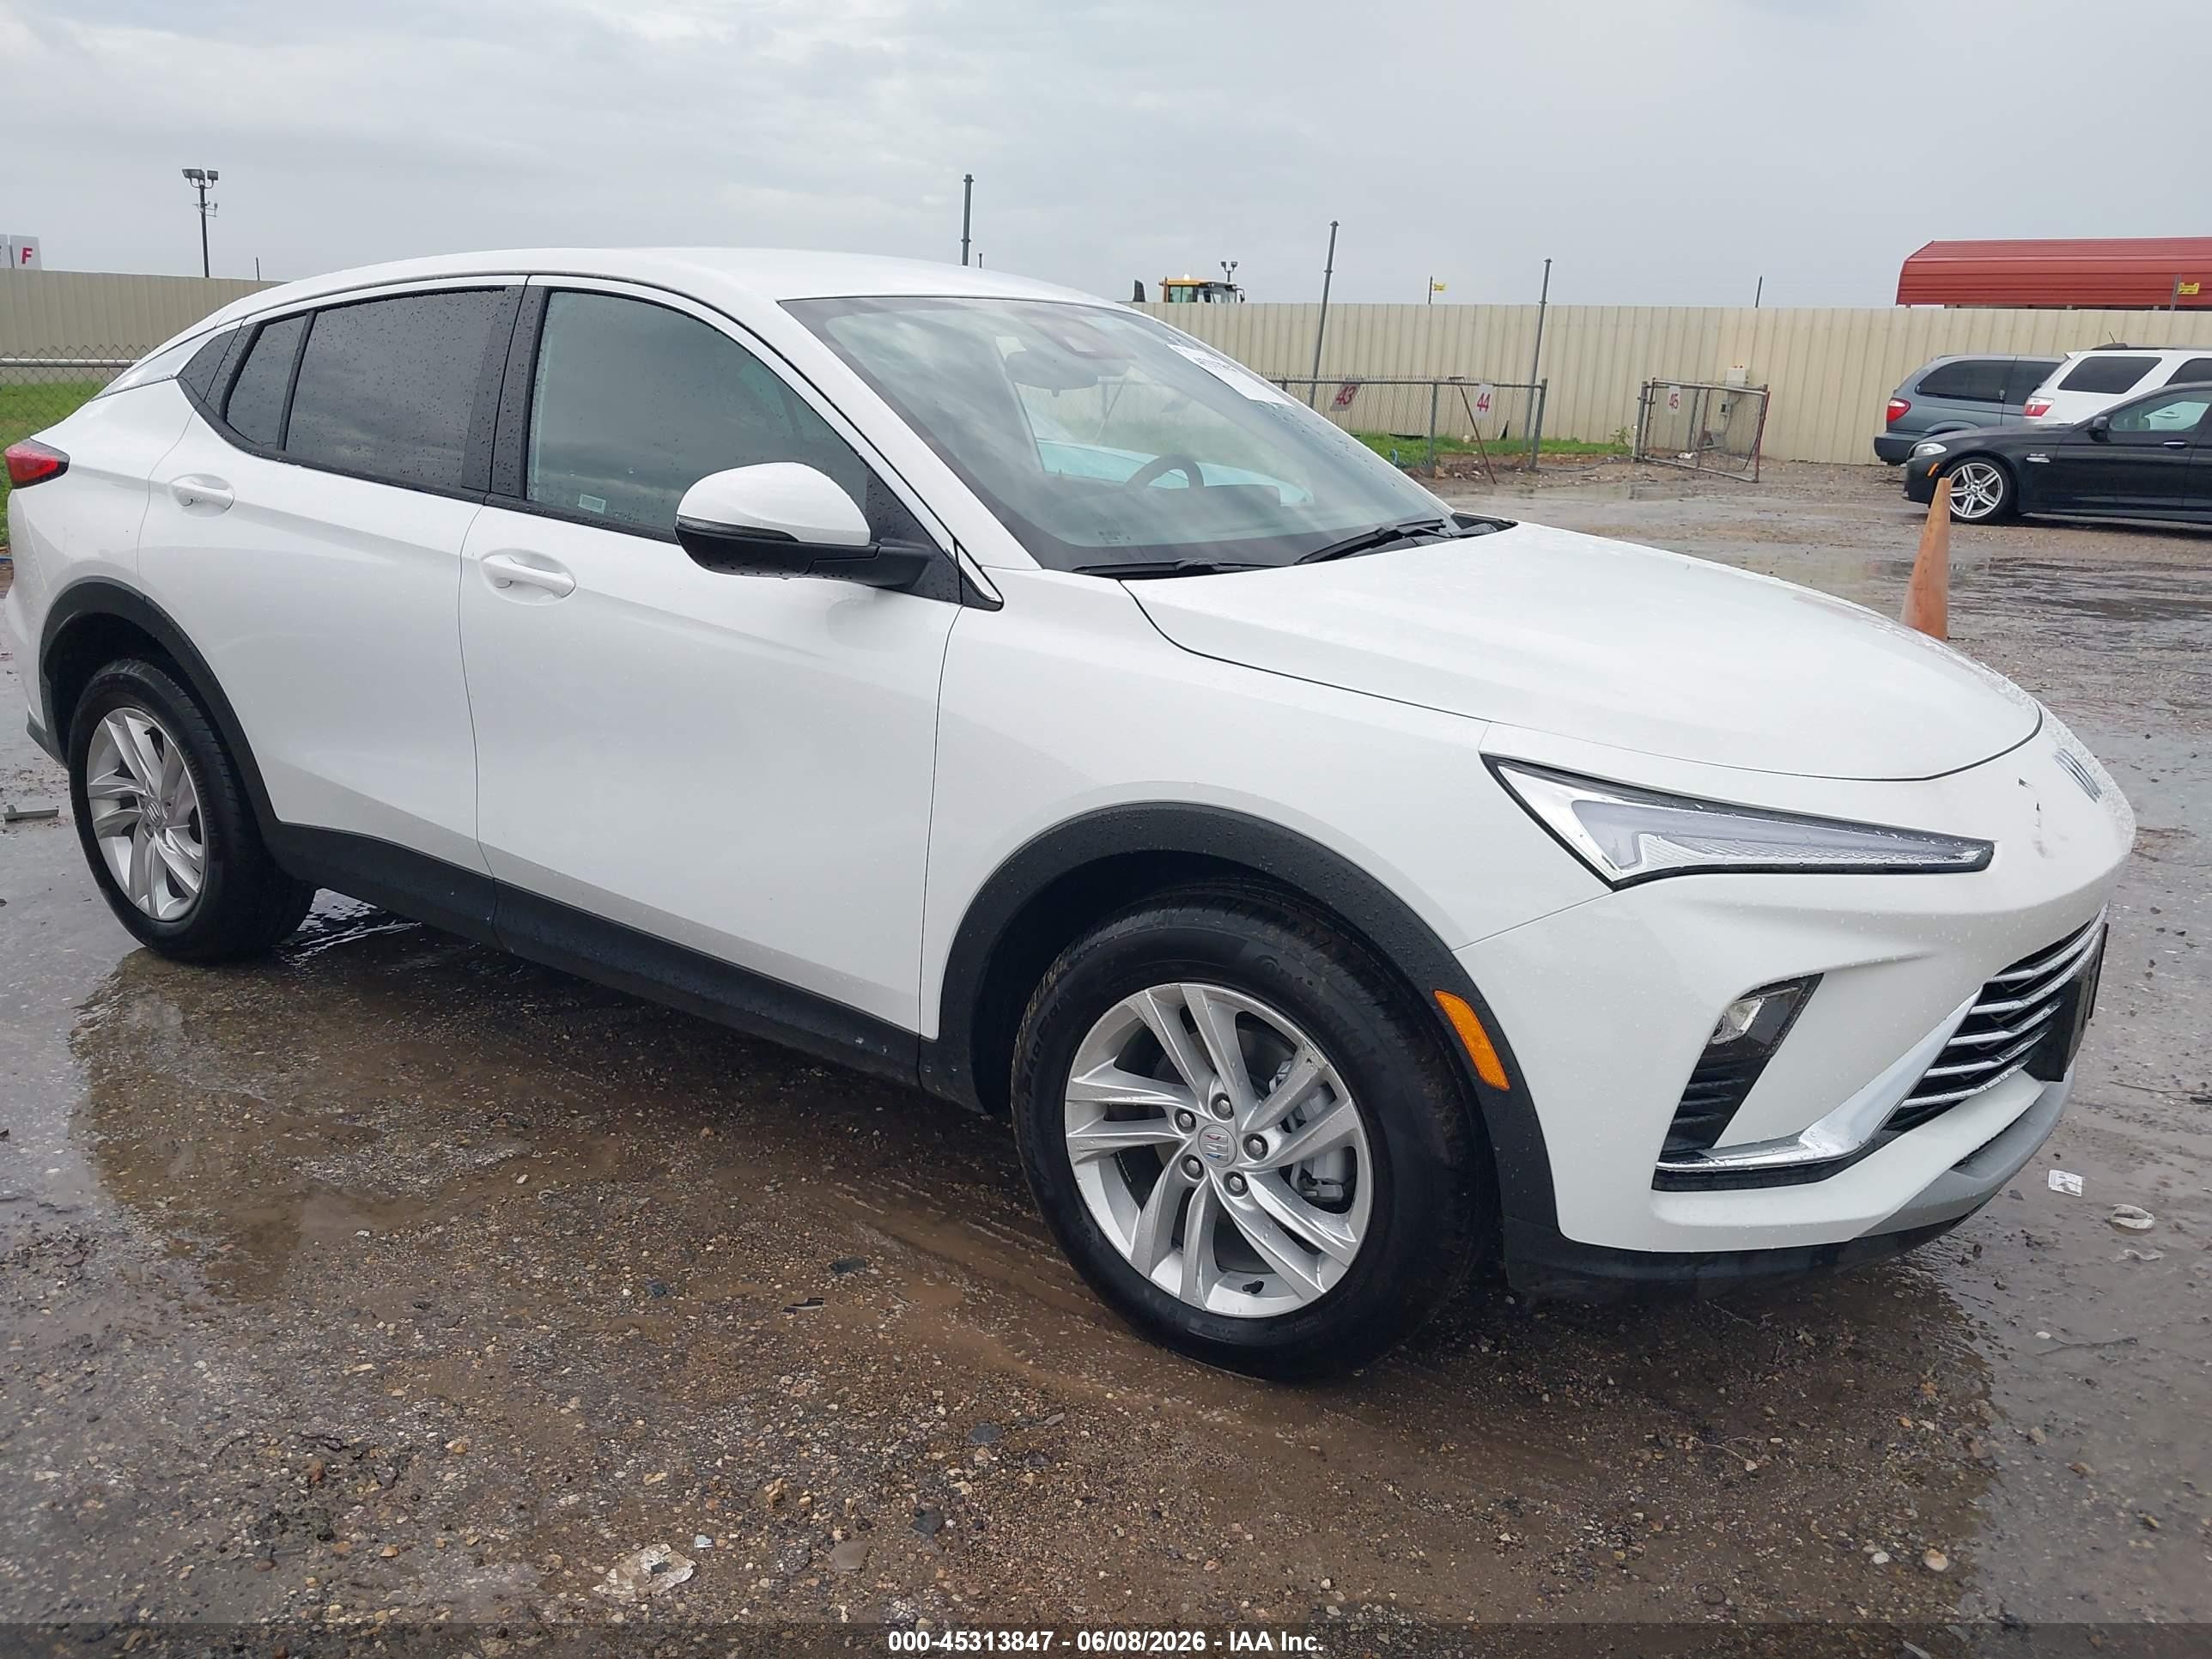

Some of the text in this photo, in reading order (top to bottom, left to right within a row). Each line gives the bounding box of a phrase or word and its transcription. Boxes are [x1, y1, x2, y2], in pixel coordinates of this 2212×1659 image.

[21, 246, 33, 264] F
[1335, 384, 1357, 405] 43
[1476, 392, 1491, 413] 44
